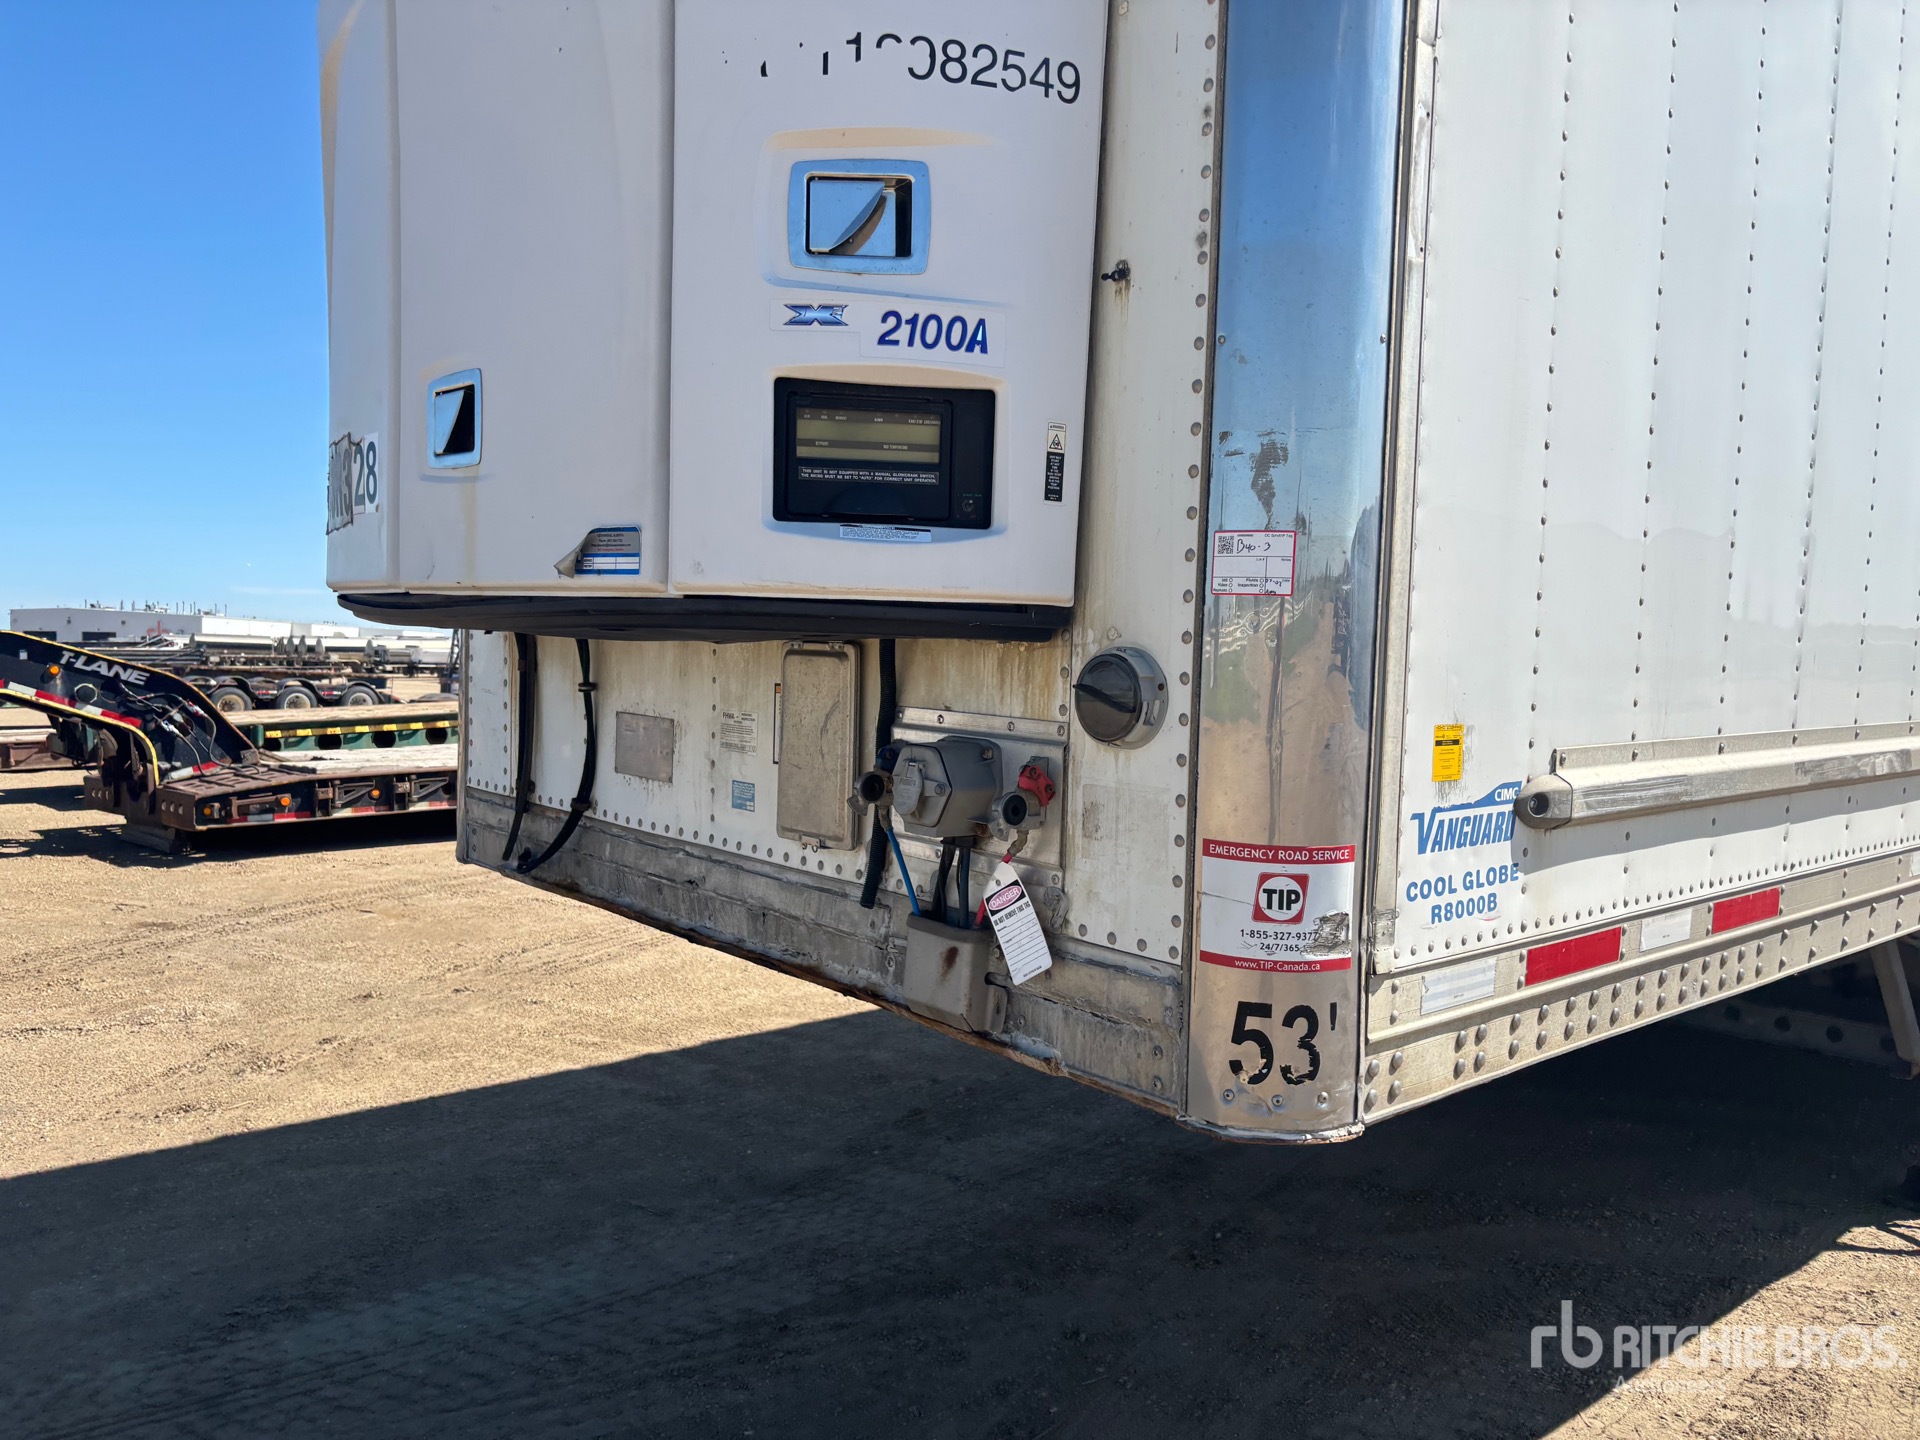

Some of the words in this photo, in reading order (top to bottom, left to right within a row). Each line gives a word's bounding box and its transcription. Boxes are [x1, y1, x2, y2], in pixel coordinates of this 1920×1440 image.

[877, 310, 988, 354] 2100A
[60, 650, 150, 686] T-LANE
[1494, 786, 1519, 801] CIMC
[1410, 808, 1516, 855] VANGUARD
[1210, 844, 1274, 860] EMERGENCY
[1278, 848, 1309, 860] ROAD
[1312, 849, 1350, 861] SERVICE
[1406, 875, 1457, 902] COOL
[1462, 862, 1519, 891] GLOBE
[991, 888, 1019, 908] DANGER
[1262, 888, 1301, 910] TIP
[1431, 893, 1497, 924] R8000B
[1004, 909, 1017, 920] REMOVE
[1260, 942, 1300, 952] 24/7/365
[1235, 960, 1320, 971] www.TIP-Canada.ca
[1229, 1001, 1337, 1085] 53'
